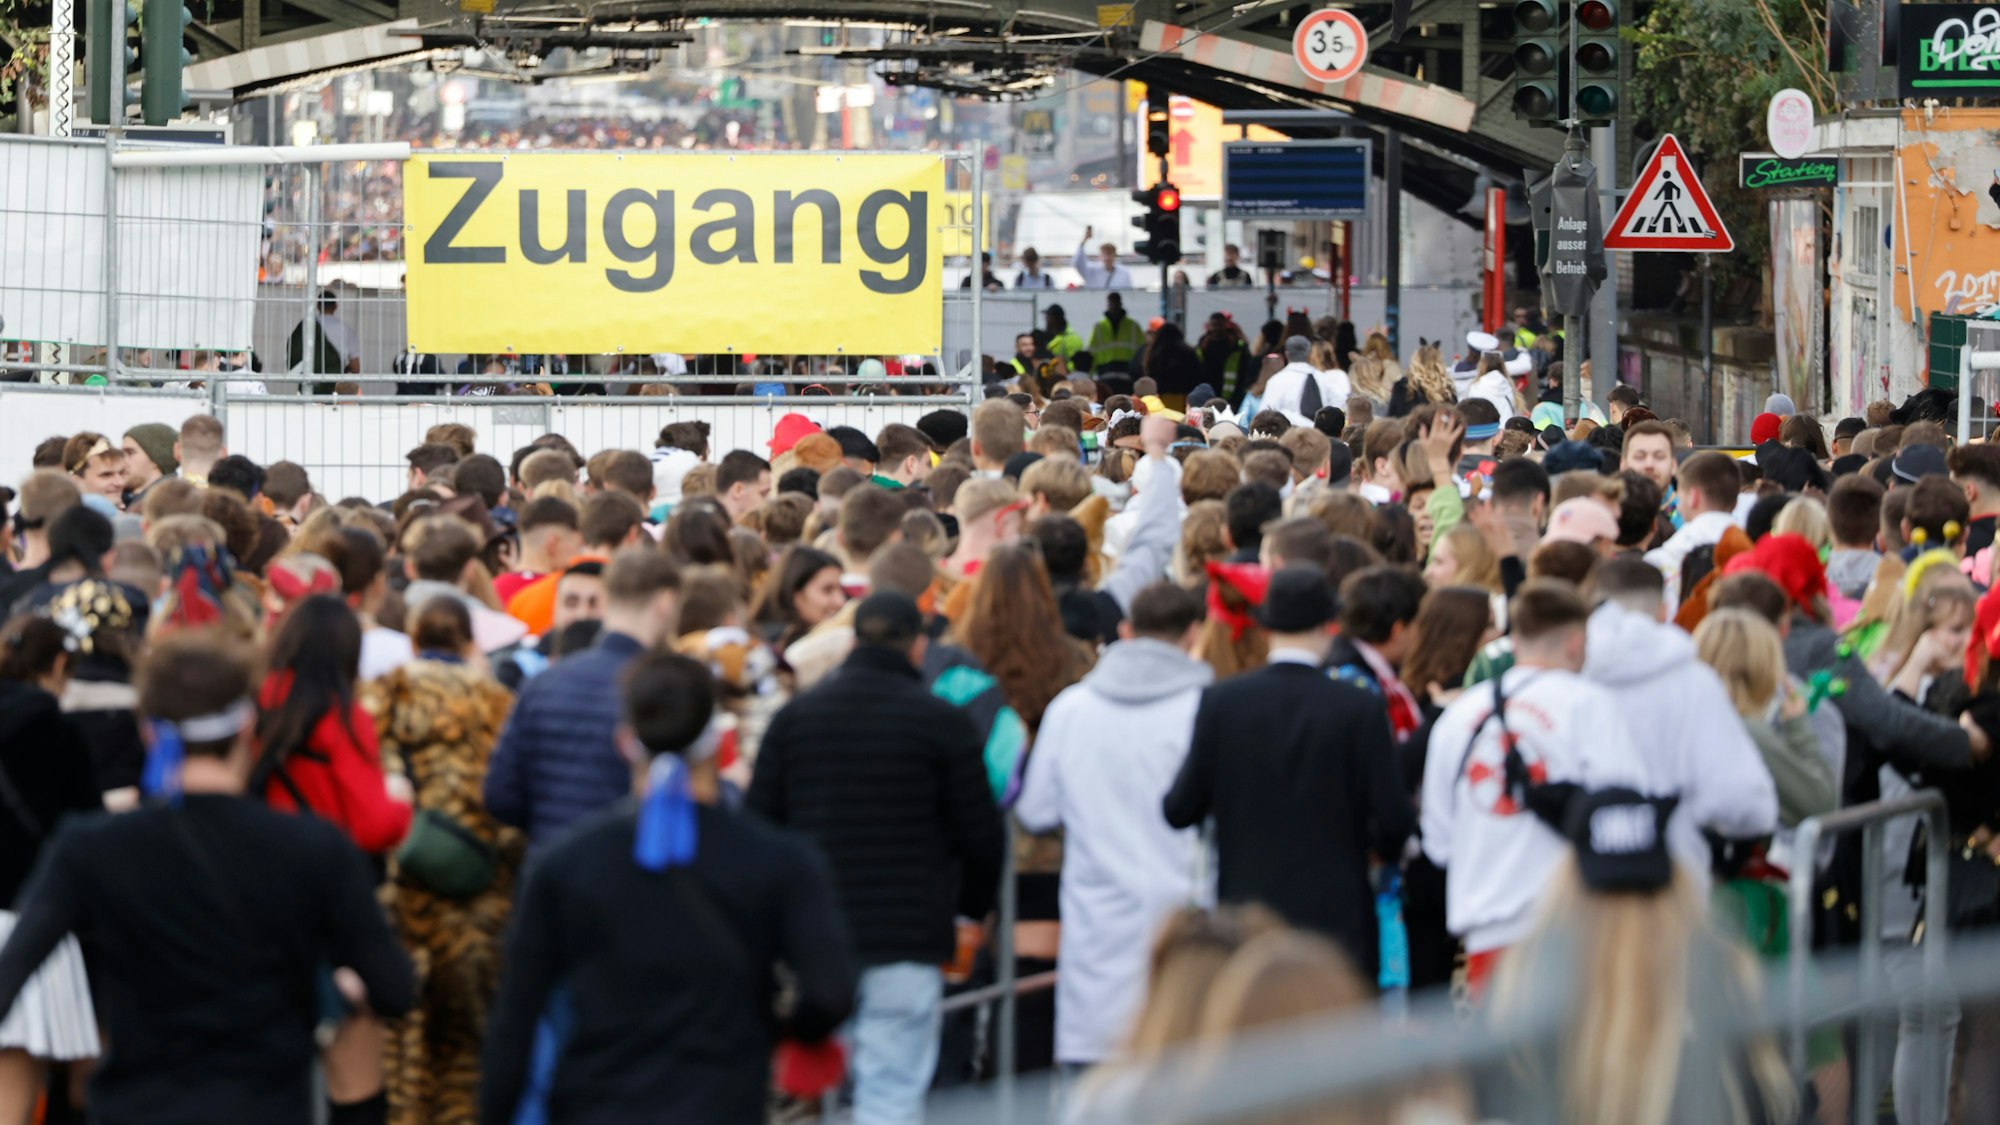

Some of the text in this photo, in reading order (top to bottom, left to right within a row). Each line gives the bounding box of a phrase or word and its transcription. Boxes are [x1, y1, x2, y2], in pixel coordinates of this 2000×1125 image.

[1746, 158, 1836, 189] Station
[423, 161, 930, 295] Zugang
[1557, 216, 1588, 234] Anlage
[1556, 239, 1588, 251] ausser
[1556, 260, 1588, 275] Betrieb
